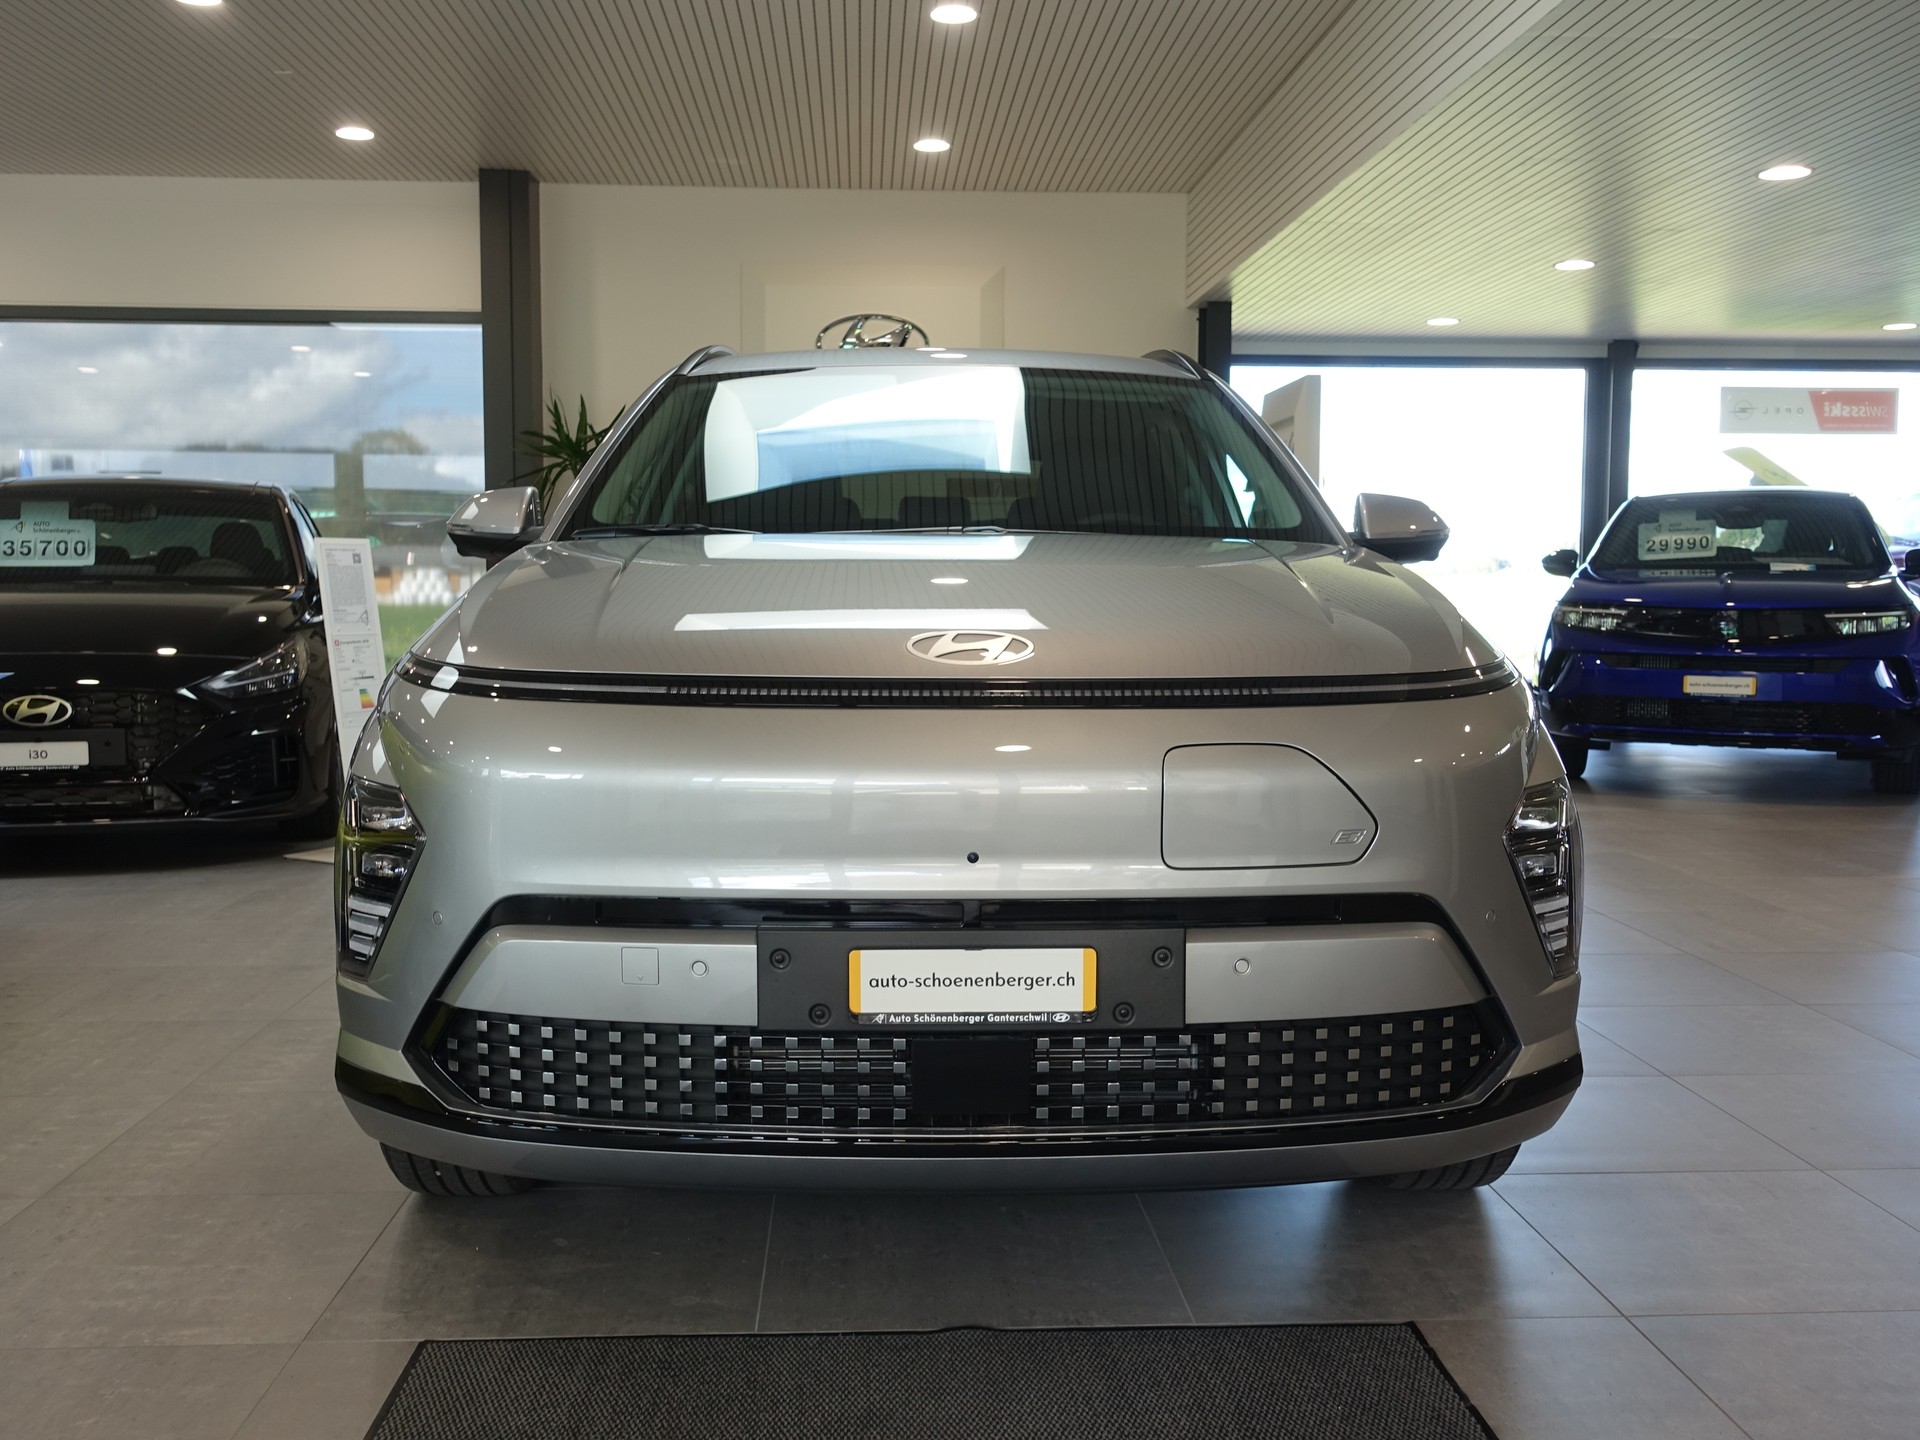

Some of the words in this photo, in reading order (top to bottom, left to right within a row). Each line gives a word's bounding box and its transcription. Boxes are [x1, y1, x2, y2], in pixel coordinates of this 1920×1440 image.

[2, 540, 86, 556] 35700
[1646, 535, 1709, 552] 29990
[28, 749, 48, 760] i30
[869, 972, 1076, 991] auto-schoenenberger.ch
[889, 1013, 911, 1023] Auto
[914, 1013, 984, 1024] Schönenberger
[987, 1012, 1047, 1022] Ganterschwil
